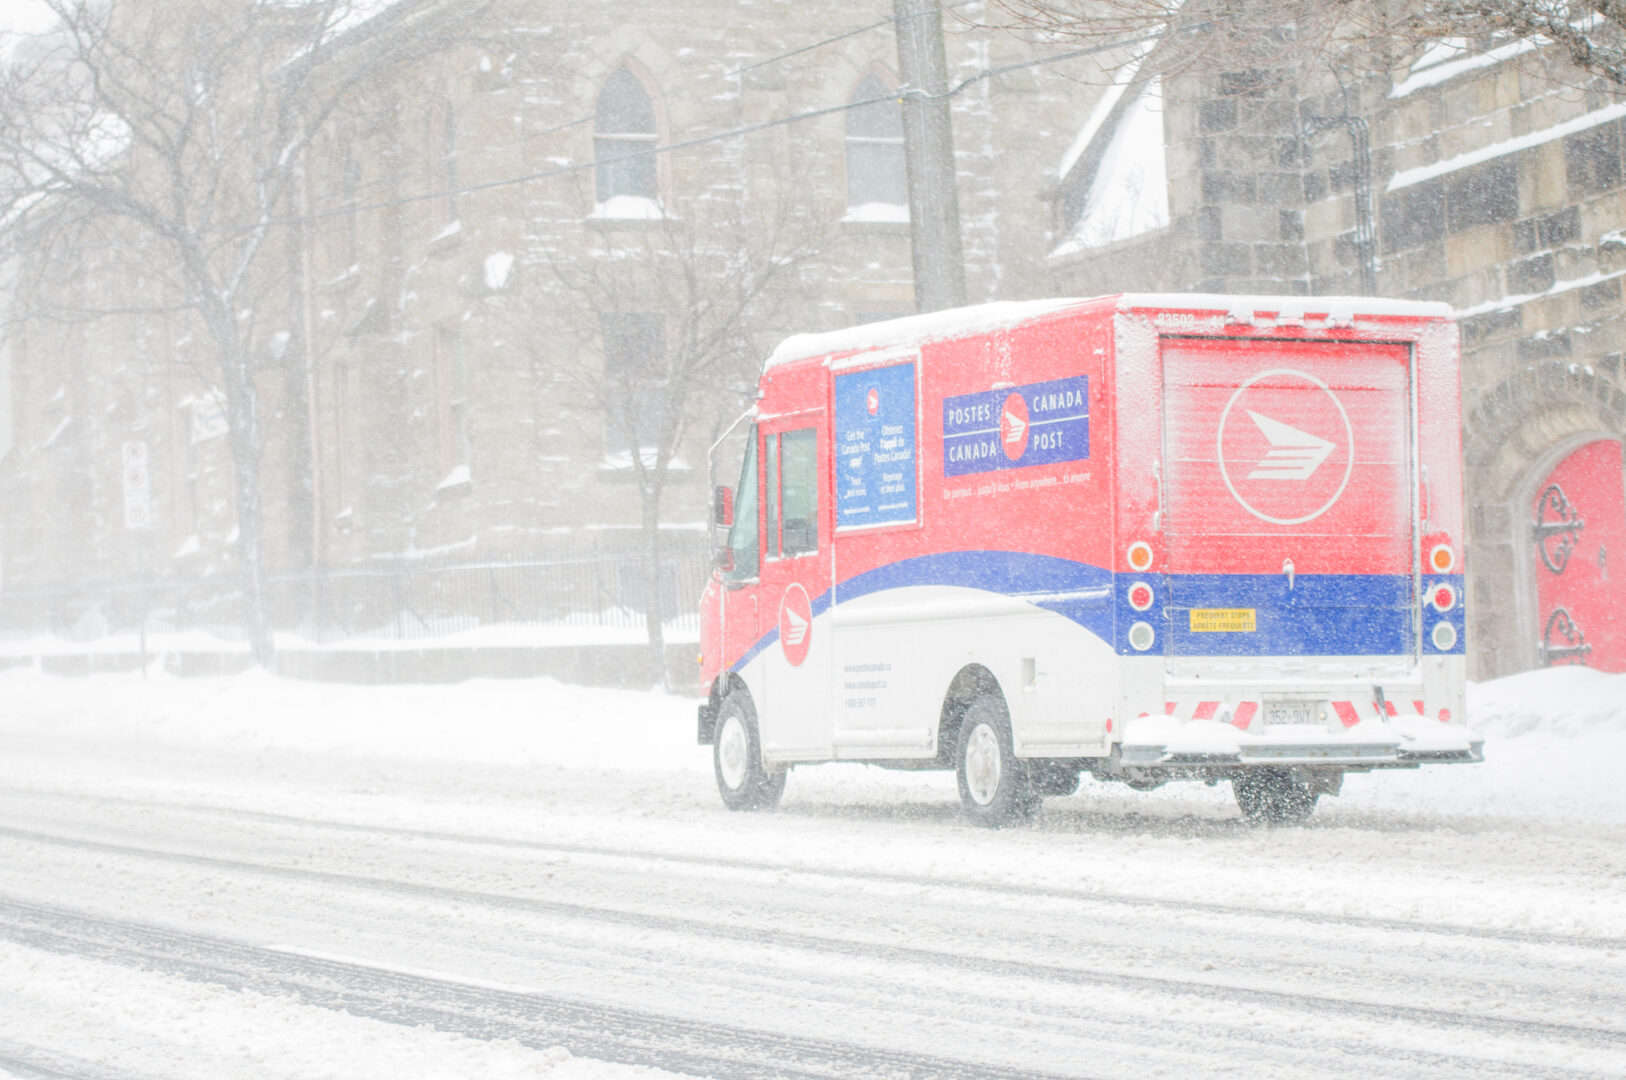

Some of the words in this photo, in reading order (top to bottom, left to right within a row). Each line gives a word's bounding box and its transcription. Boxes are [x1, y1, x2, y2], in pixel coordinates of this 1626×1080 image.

[949, 404, 991, 425] POSTES
[1033, 390, 1083, 413] CANADA
[949, 440, 997, 462] CANADA
[1033, 431, 1064, 451] POST
